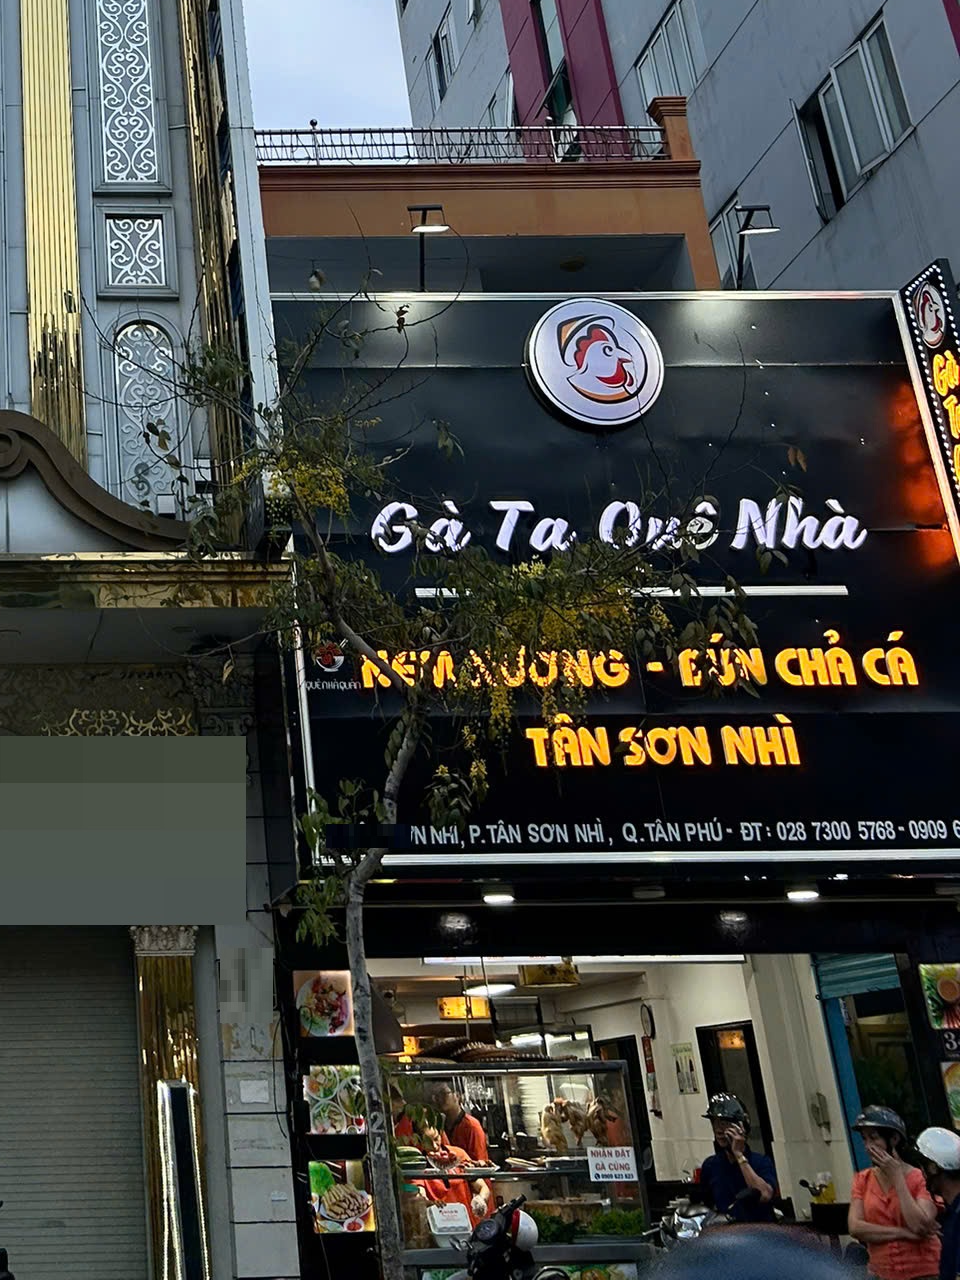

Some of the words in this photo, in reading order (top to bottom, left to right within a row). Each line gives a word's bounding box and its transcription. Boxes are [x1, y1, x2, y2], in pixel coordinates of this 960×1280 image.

[372, 500, 471, 553] Gà
[490, 501, 576, 552] Ta
[730, 496, 868, 550] Nhà
[775, 629, 857, 686] CHẢ
[862, 630, 920, 686] CÁ
[526, 713, 611, 766] TÂN
[618, 725, 712, 766] SƠN
[720, 713, 801, 766] NHÌ
[528, 823, 569, 844] SƠN
[776, 822, 807, 841] 028
[812, 821, 851, 841] 7300
[857, 821, 896, 840] 5768
[908, 820, 948, 840] 0909
